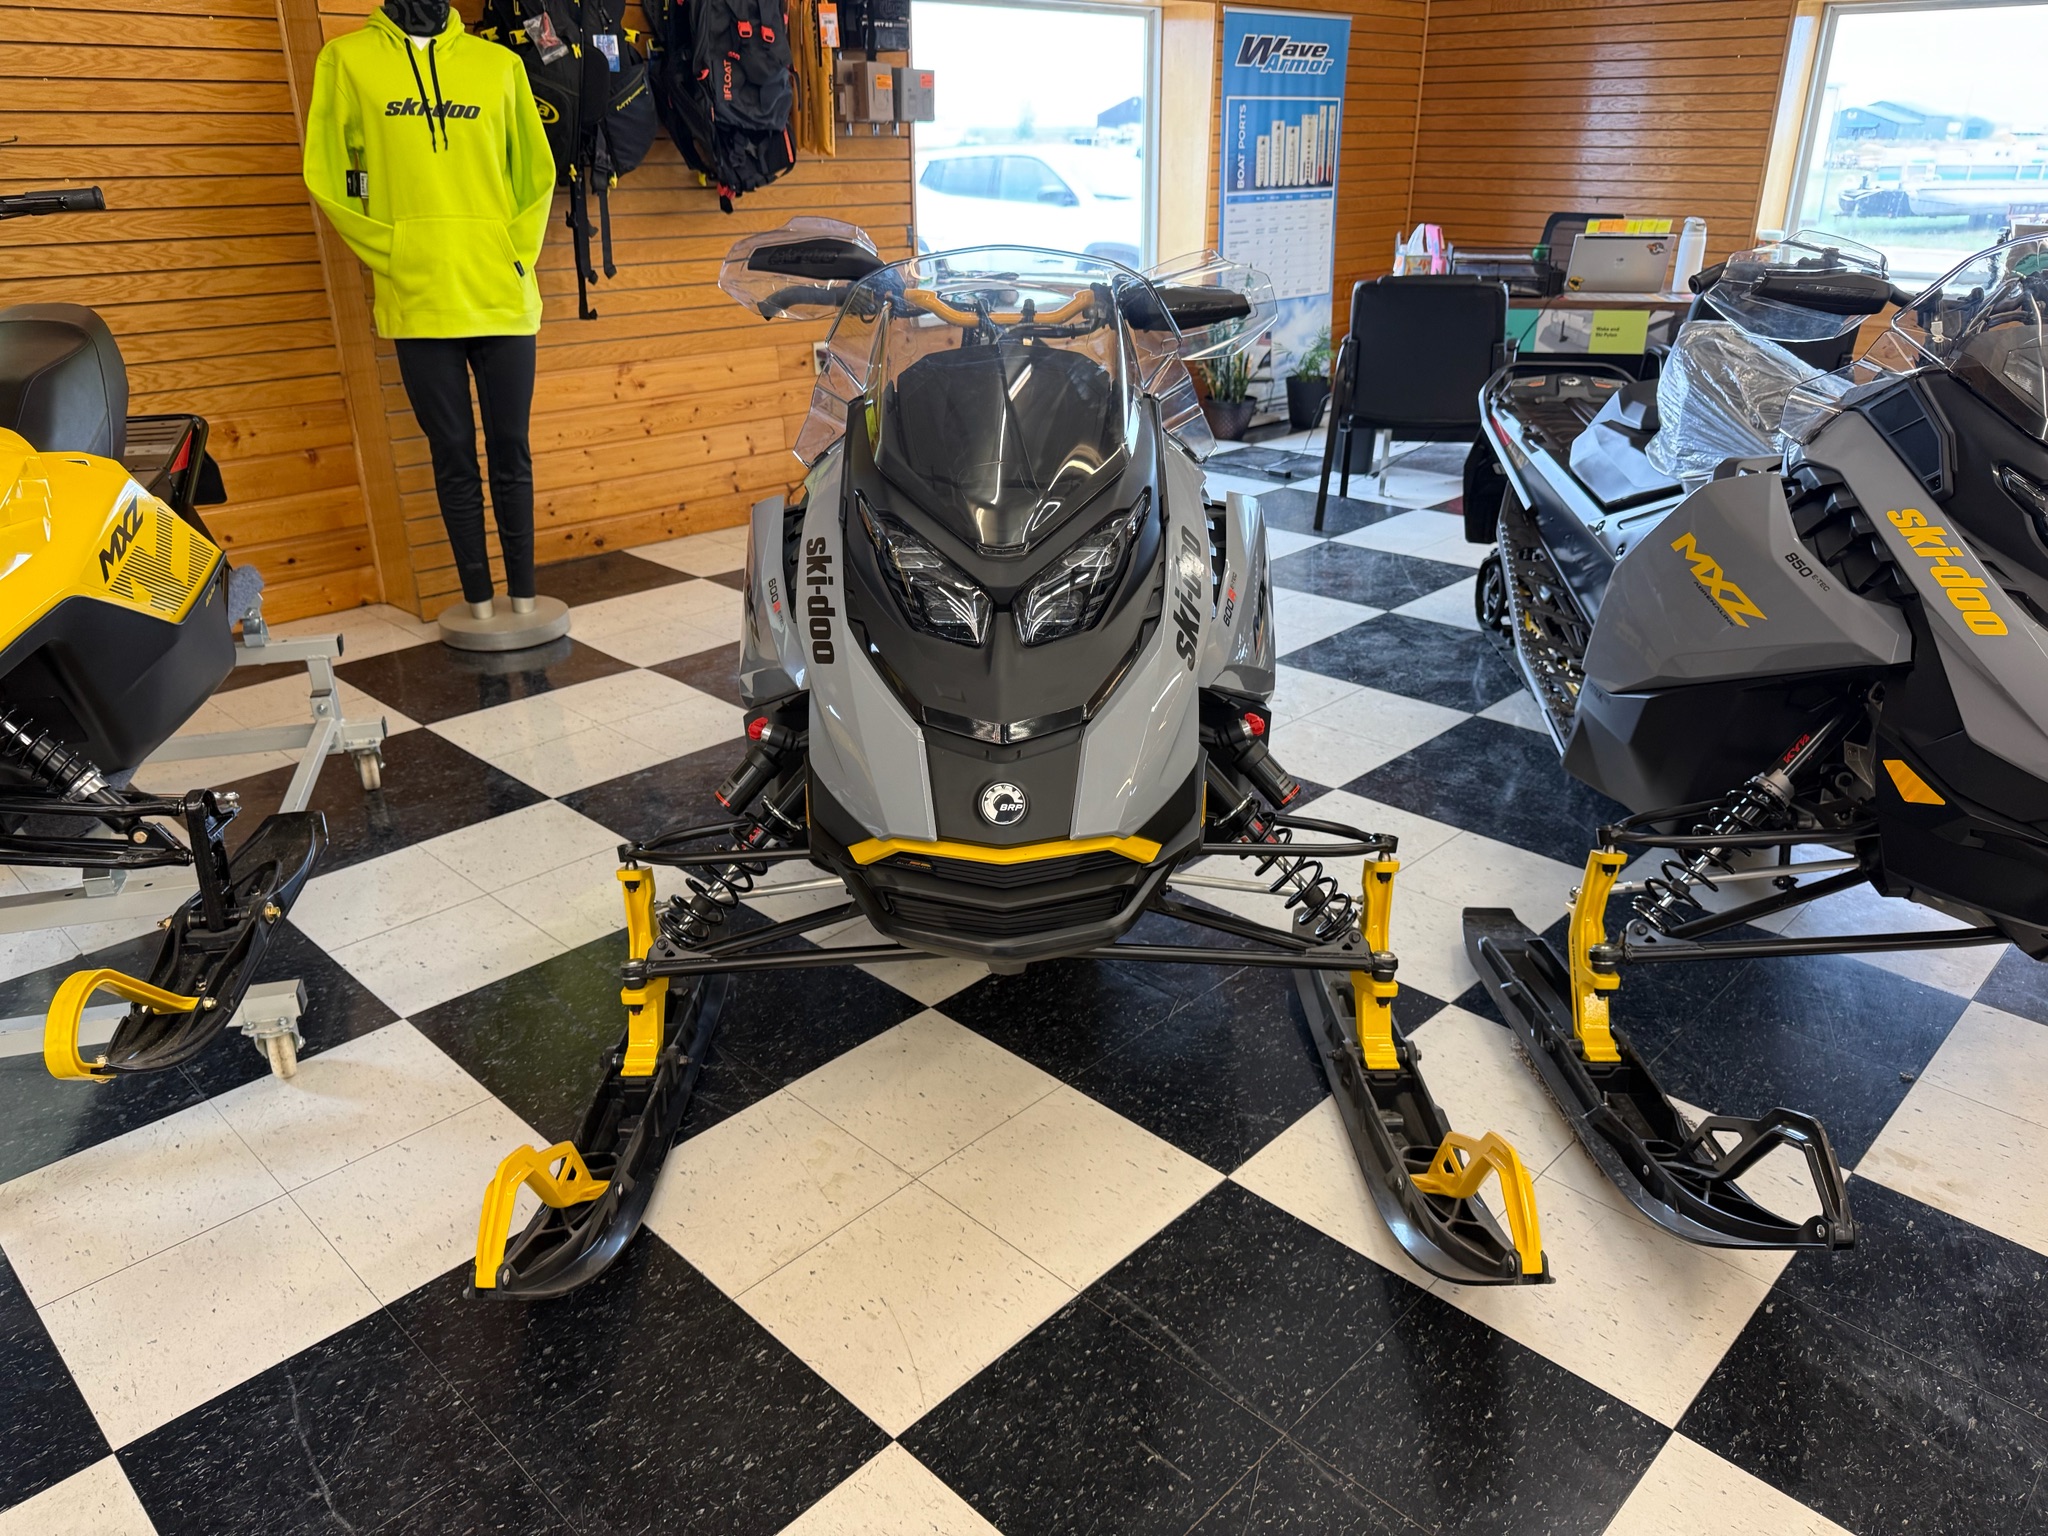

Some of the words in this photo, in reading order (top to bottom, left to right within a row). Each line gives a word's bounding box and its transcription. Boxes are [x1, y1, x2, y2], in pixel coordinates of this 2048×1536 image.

[1235, 34, 1329, 67] Wave
[1260, 52, 1334, 75] Armor
[1238, 104, 1247, 149] PORTS
[1237, 153, 1245, 189] BOAT
[98, 494, 144, 584] MXZ
[1670, 532, 1768, 628] MXZ
[1785, 552, 1813, 578] 850
[1811, 574, 1831, 592] E-TEC
[1886, 508, 2009, 636] ski-doo
[806, 537, 836, 664] ski-doo
[1693, 581, 1735, 627] ADRENALINE
[1000, 803, 1023, 811] BRP
